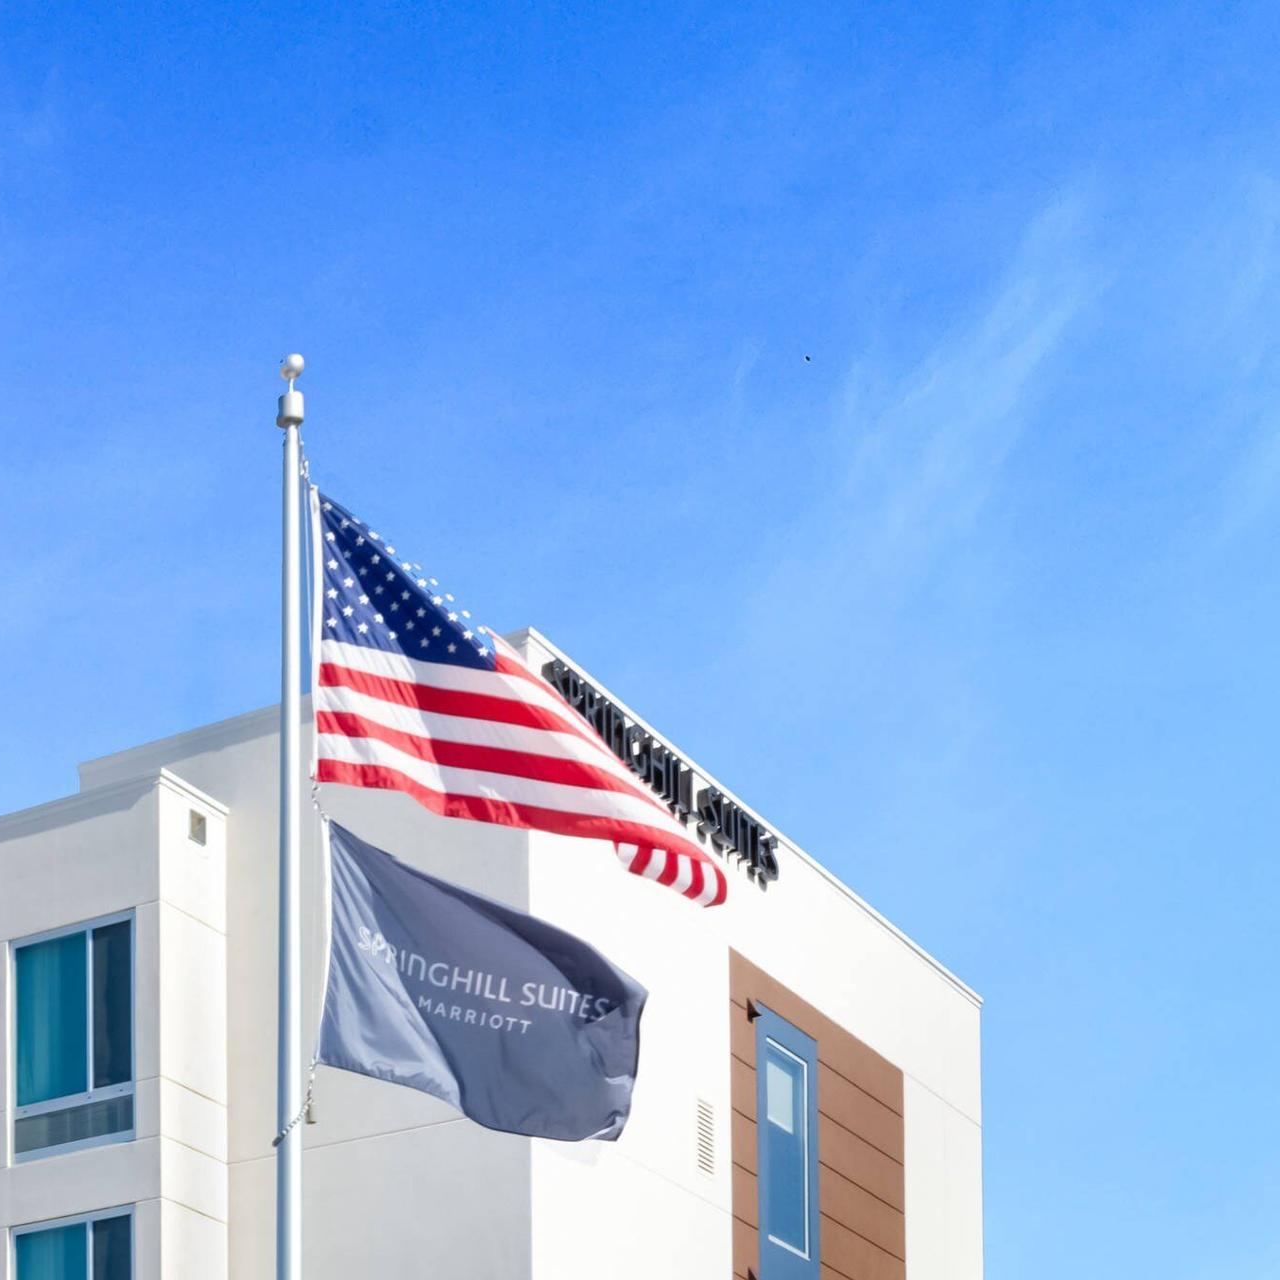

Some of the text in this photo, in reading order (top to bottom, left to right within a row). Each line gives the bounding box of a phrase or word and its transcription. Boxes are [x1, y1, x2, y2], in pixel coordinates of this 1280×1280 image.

[697, 785, 779, 881] SUITES
[358, 926, 610, 1022] SPRINGHILL SUITES
[418, 995, 532, 1034] MARRIOTT
